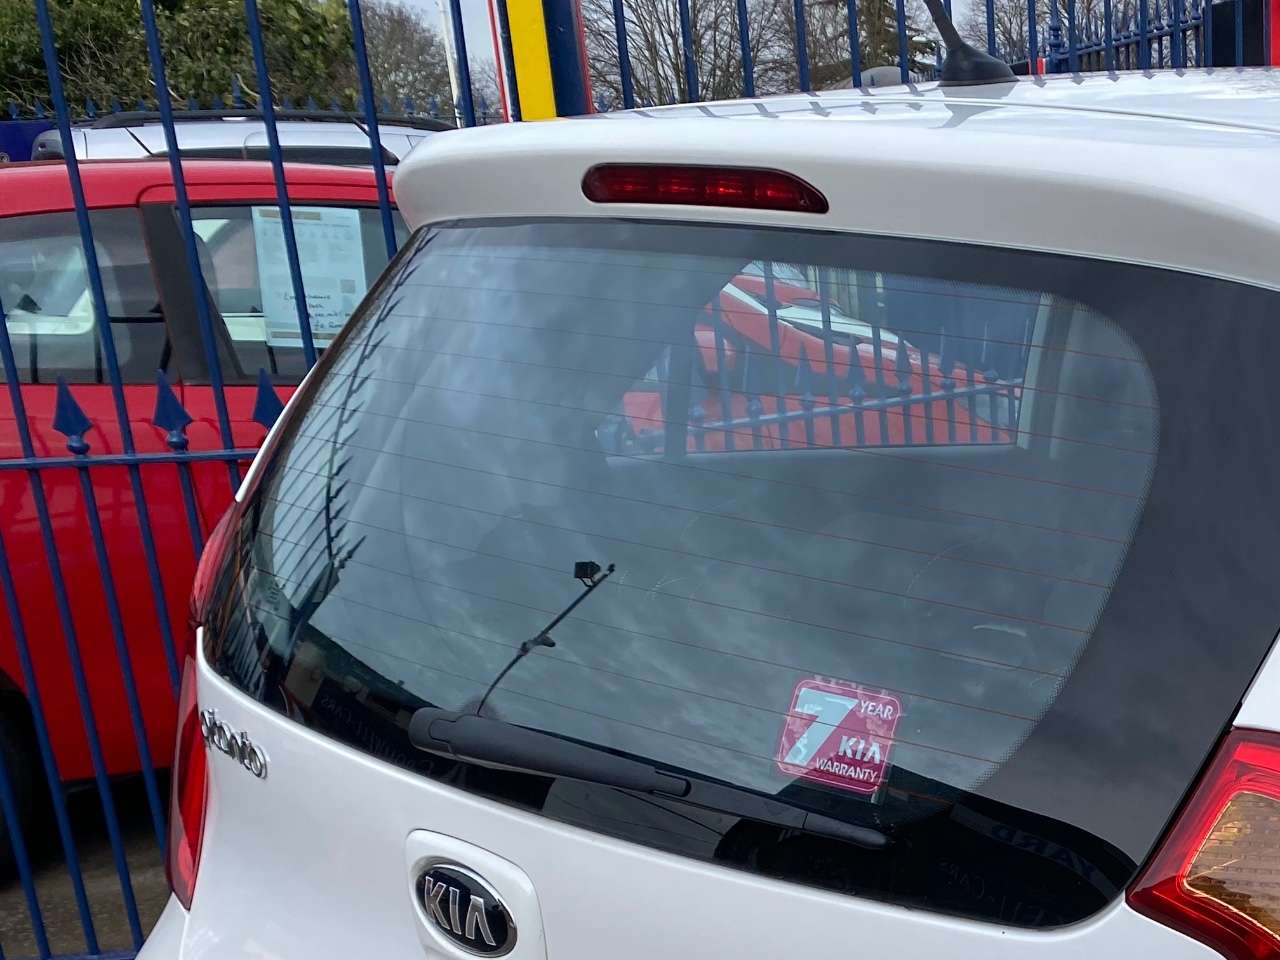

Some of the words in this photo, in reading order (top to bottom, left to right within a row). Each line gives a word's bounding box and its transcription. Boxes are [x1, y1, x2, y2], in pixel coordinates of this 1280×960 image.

[784, 687, 859, 766] 7
[859, 700, 894, 721] YEAR
[838, 735, 881, 765] KIA
[815, 757, 878, 783] WARRANTY
[424, 875, 497, 947] KIA
